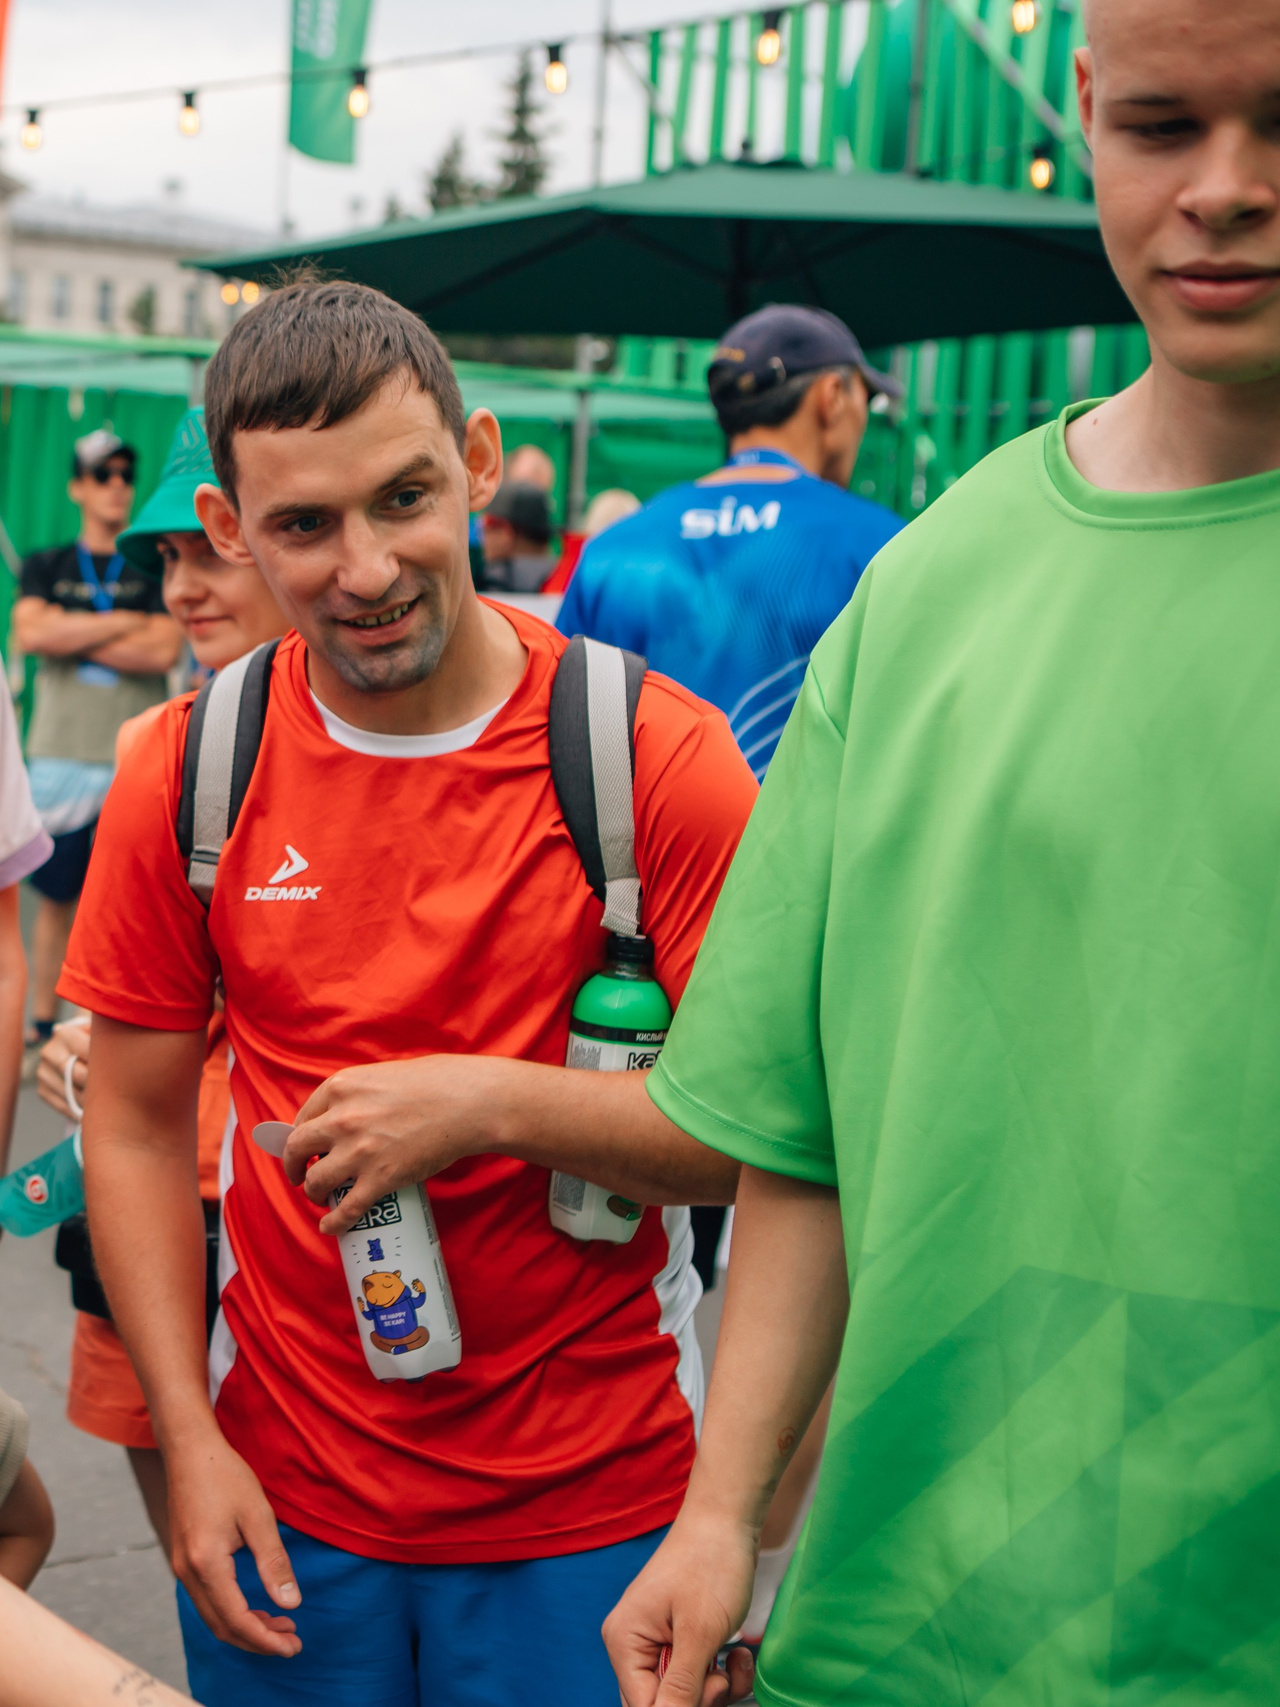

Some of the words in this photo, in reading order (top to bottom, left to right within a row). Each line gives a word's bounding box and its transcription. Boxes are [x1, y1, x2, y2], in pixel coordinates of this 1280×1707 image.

[245, 886, 322, 900] DEMIX
[636, 1031, 663, 1042] КИСЛЫЙ
[388, 1311, 406, 1319] HAPPY
